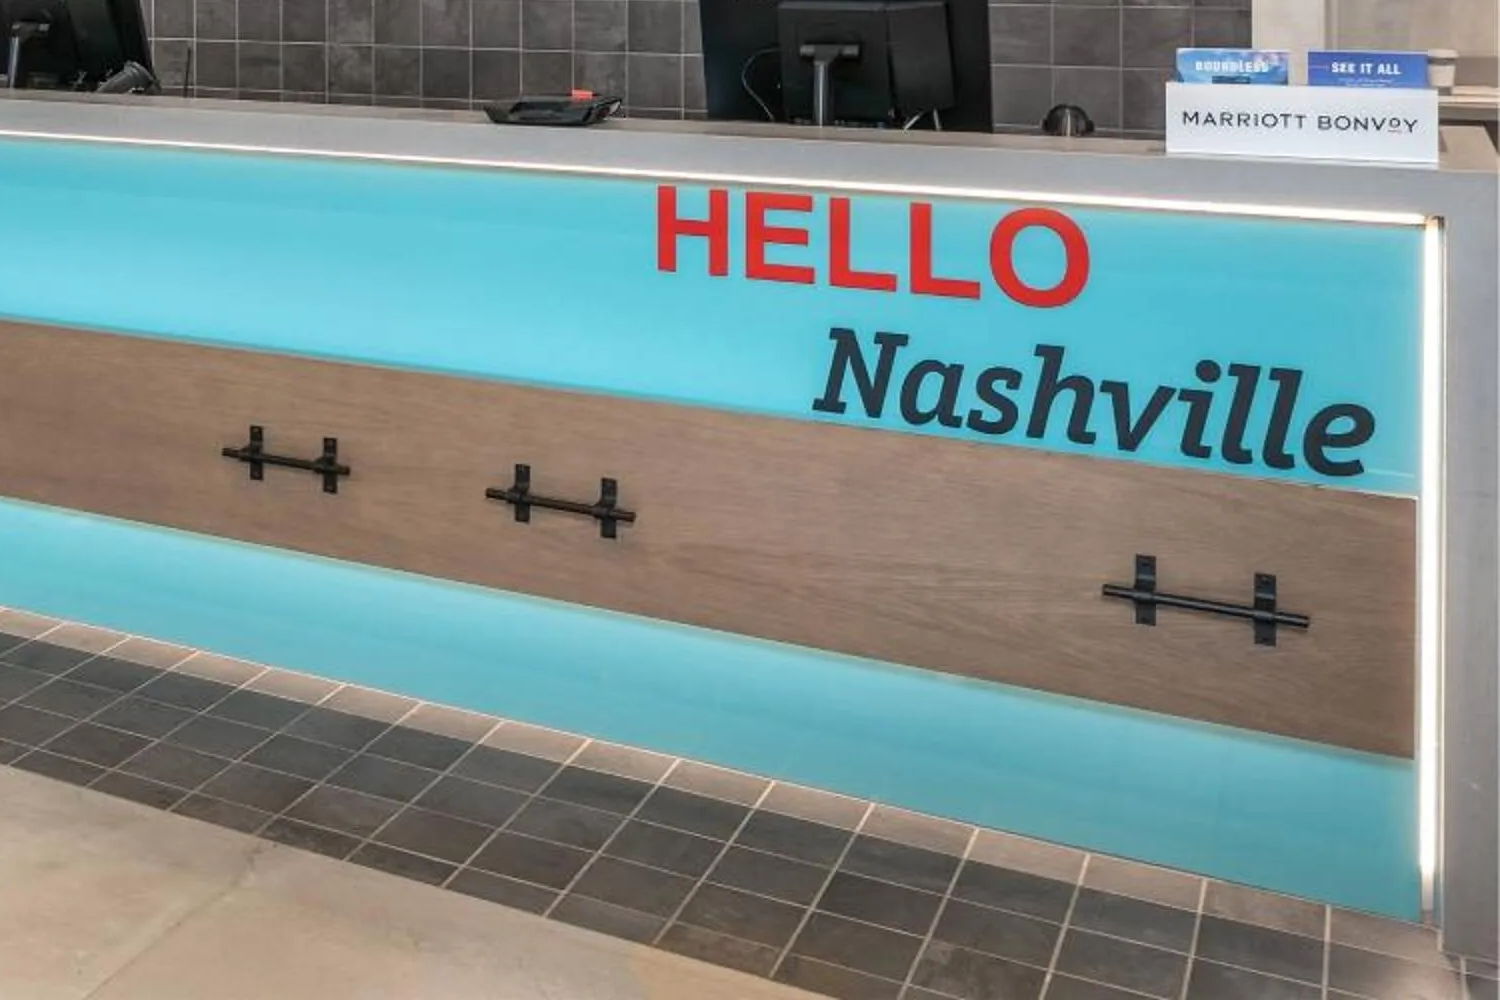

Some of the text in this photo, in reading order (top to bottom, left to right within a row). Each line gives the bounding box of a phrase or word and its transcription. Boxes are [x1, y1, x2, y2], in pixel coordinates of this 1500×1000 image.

[1331, 62, 1401, 76] SEE IT ALL
[1182, 110, 1307, 130] MARRIOTT
[657, 185, 1090, 308] HELLO
[812, 327, 1376, 477] Nashville
